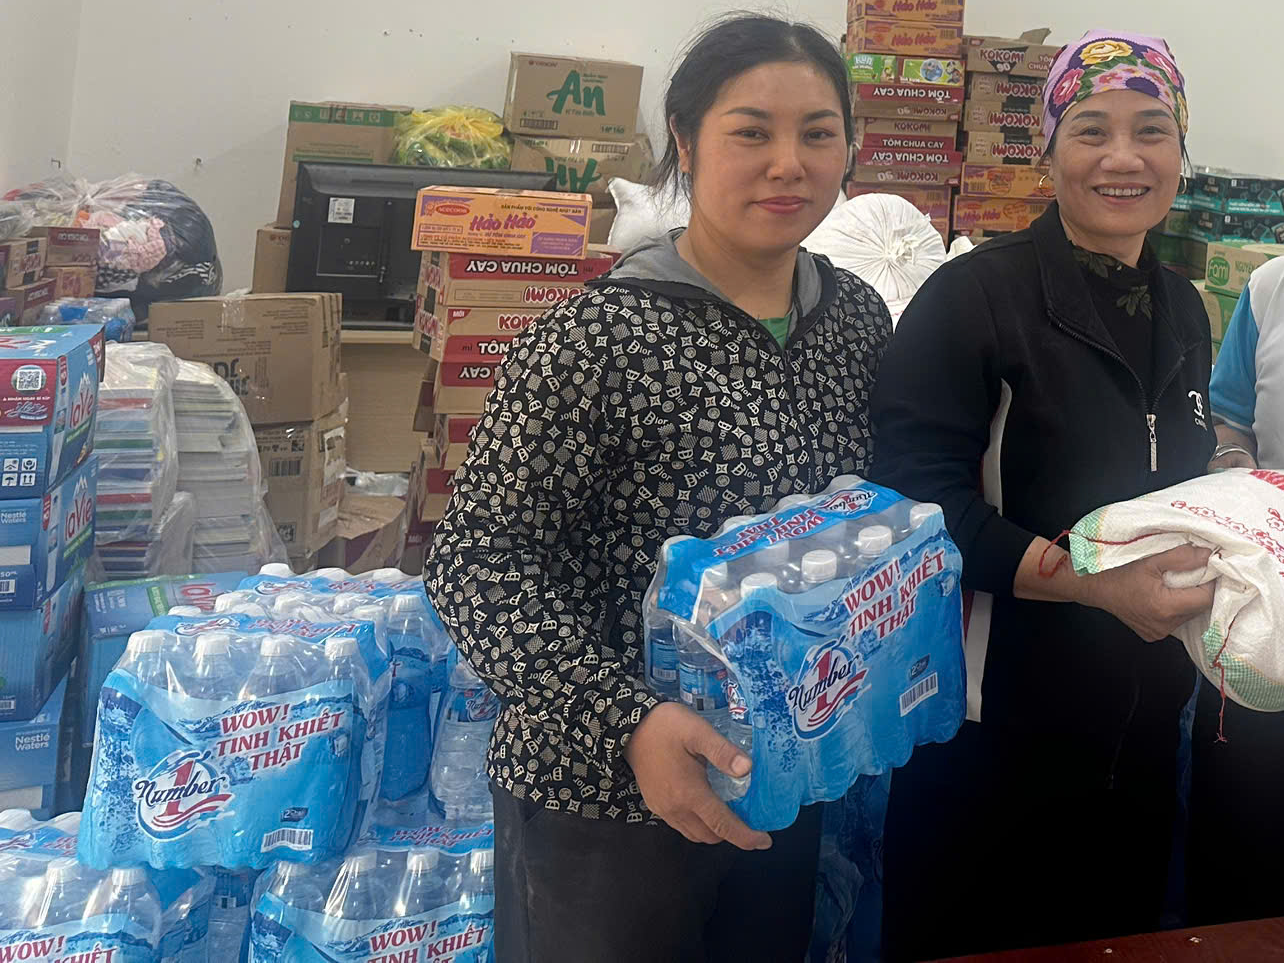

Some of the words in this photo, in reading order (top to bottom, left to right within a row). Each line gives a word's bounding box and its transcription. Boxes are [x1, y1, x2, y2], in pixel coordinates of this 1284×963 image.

[980, 48, 1025, 63] KOKOMI
[996, 63, 1011, 72] 90
[546, 69, 606, 116] An
[873, 87, 895, 96] CAY
[896, 88, 926, 97] CHUA
[913, 106, 947, 115] KOKOMI
[894, 122, 931, 132] KOKOMI
[988, 112, 1041, 128] KOKOMI
[882, 138, 901, 147] TÔM
[902, 140, 926, 148] CHUA
[927, 141, 945, 149] CAY
[991, 142, 1042, 158] KOKOMI
[872, 151, 893, 161] CAY
[895, 152, 925, 162] CHUA
[896, 171, 938, 182] KOKOMI
[469, 212, 501, 231] Hảo
[503, 211, 537, 230] Hảo
[467, 259, 498, 272] CAY
[501, 260, 542, 274] CHUA
[545, 261, 578, 277] TÔM
[603, 286, 629, 295] Dior
[647, 324, 667, 339] Dior
[575, 340, 594, 359] Dior
[725, 332, 743, 353] Dior
[459, 366, 491, 379] CAY
[626, 369, 640, 393] Dior
[525, 391, 542, 412] Dior
[643, 411, 668, 425] Dior
[564, 426, 576, 451] Dior
[685, 468, 710, 487] Dior
[768, 460, 784, 481] Dior
[719, 489, 738, 513] Dior
[843, 561, 900, 614] WOW!
[849, 595, 893, 637] TINH
[898, 548, 946, 604] KHIẾT
[788, 653, 863, 713] Number
[219, 703, 289, 734] WOW!
[618, 707, 642, 728] Dior
[15, 733, 50, 743] Nestlé
[216, 729, 272, 760] TINH
[277, 706, 346, 742] KHIẾT
[15, 741, 49, 751] Waters
[249, 739, 305, 773] THẬT
[133, 772, 224, 806] Number
[573, 778, 596, 797] Dior
[370, 921, 437, 952] WOW!
[427, 922, 489, 960] KHIẾT
